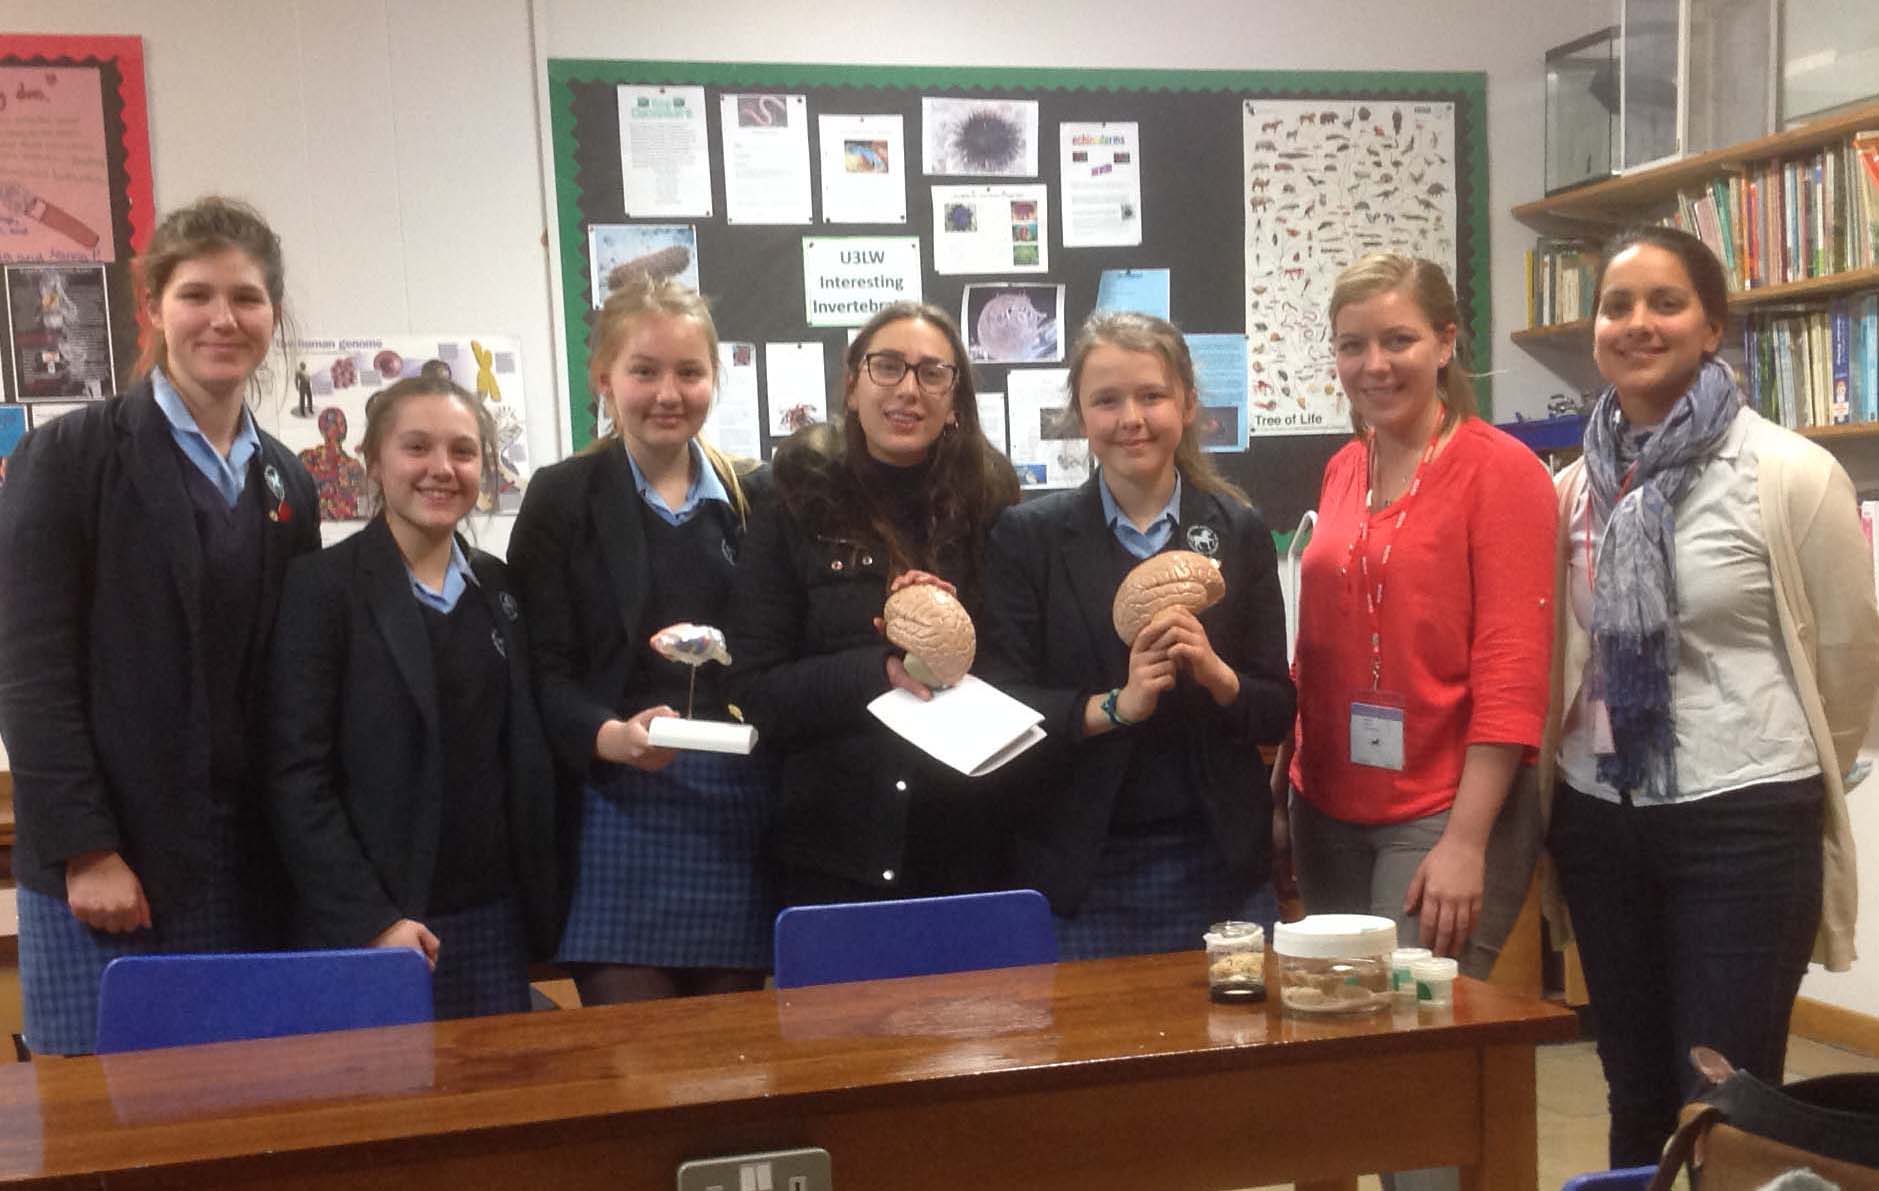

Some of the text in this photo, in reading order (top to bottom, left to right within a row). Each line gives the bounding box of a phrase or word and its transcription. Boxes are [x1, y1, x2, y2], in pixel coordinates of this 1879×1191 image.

[840, 250, 885, 264] U3LW
[820, 274, 904, 291] Interesting
[813, 298, 899, 314] Invertebr
[339, 338, 383, 351] genome
[1255, 413, 1323, 426] Tree of Life
